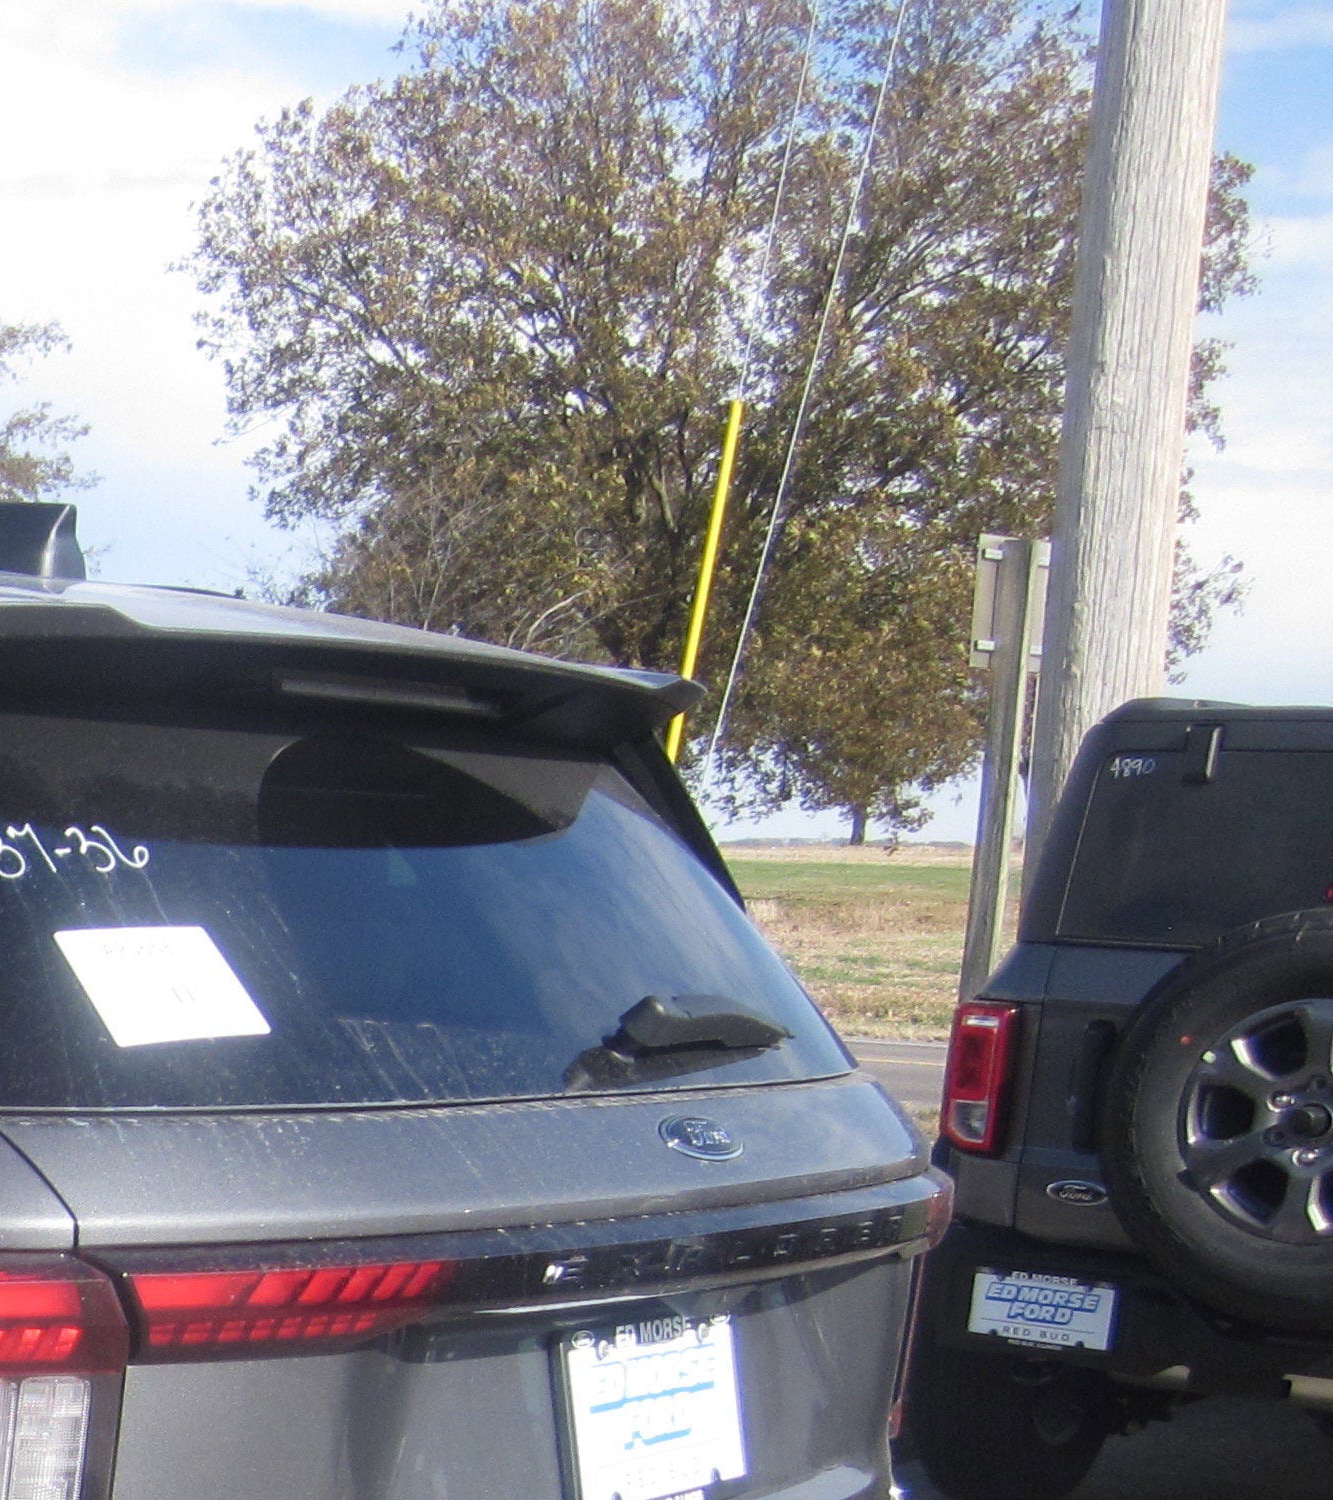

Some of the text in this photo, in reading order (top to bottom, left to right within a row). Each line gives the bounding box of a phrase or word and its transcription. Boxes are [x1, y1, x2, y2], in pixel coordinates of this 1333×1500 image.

[986, 1282, 1100, 1311] ED MORSE
[1009, 1303, 1072, 1323] FORD
[1002, 1325, 1070, 1342] RED BUD
